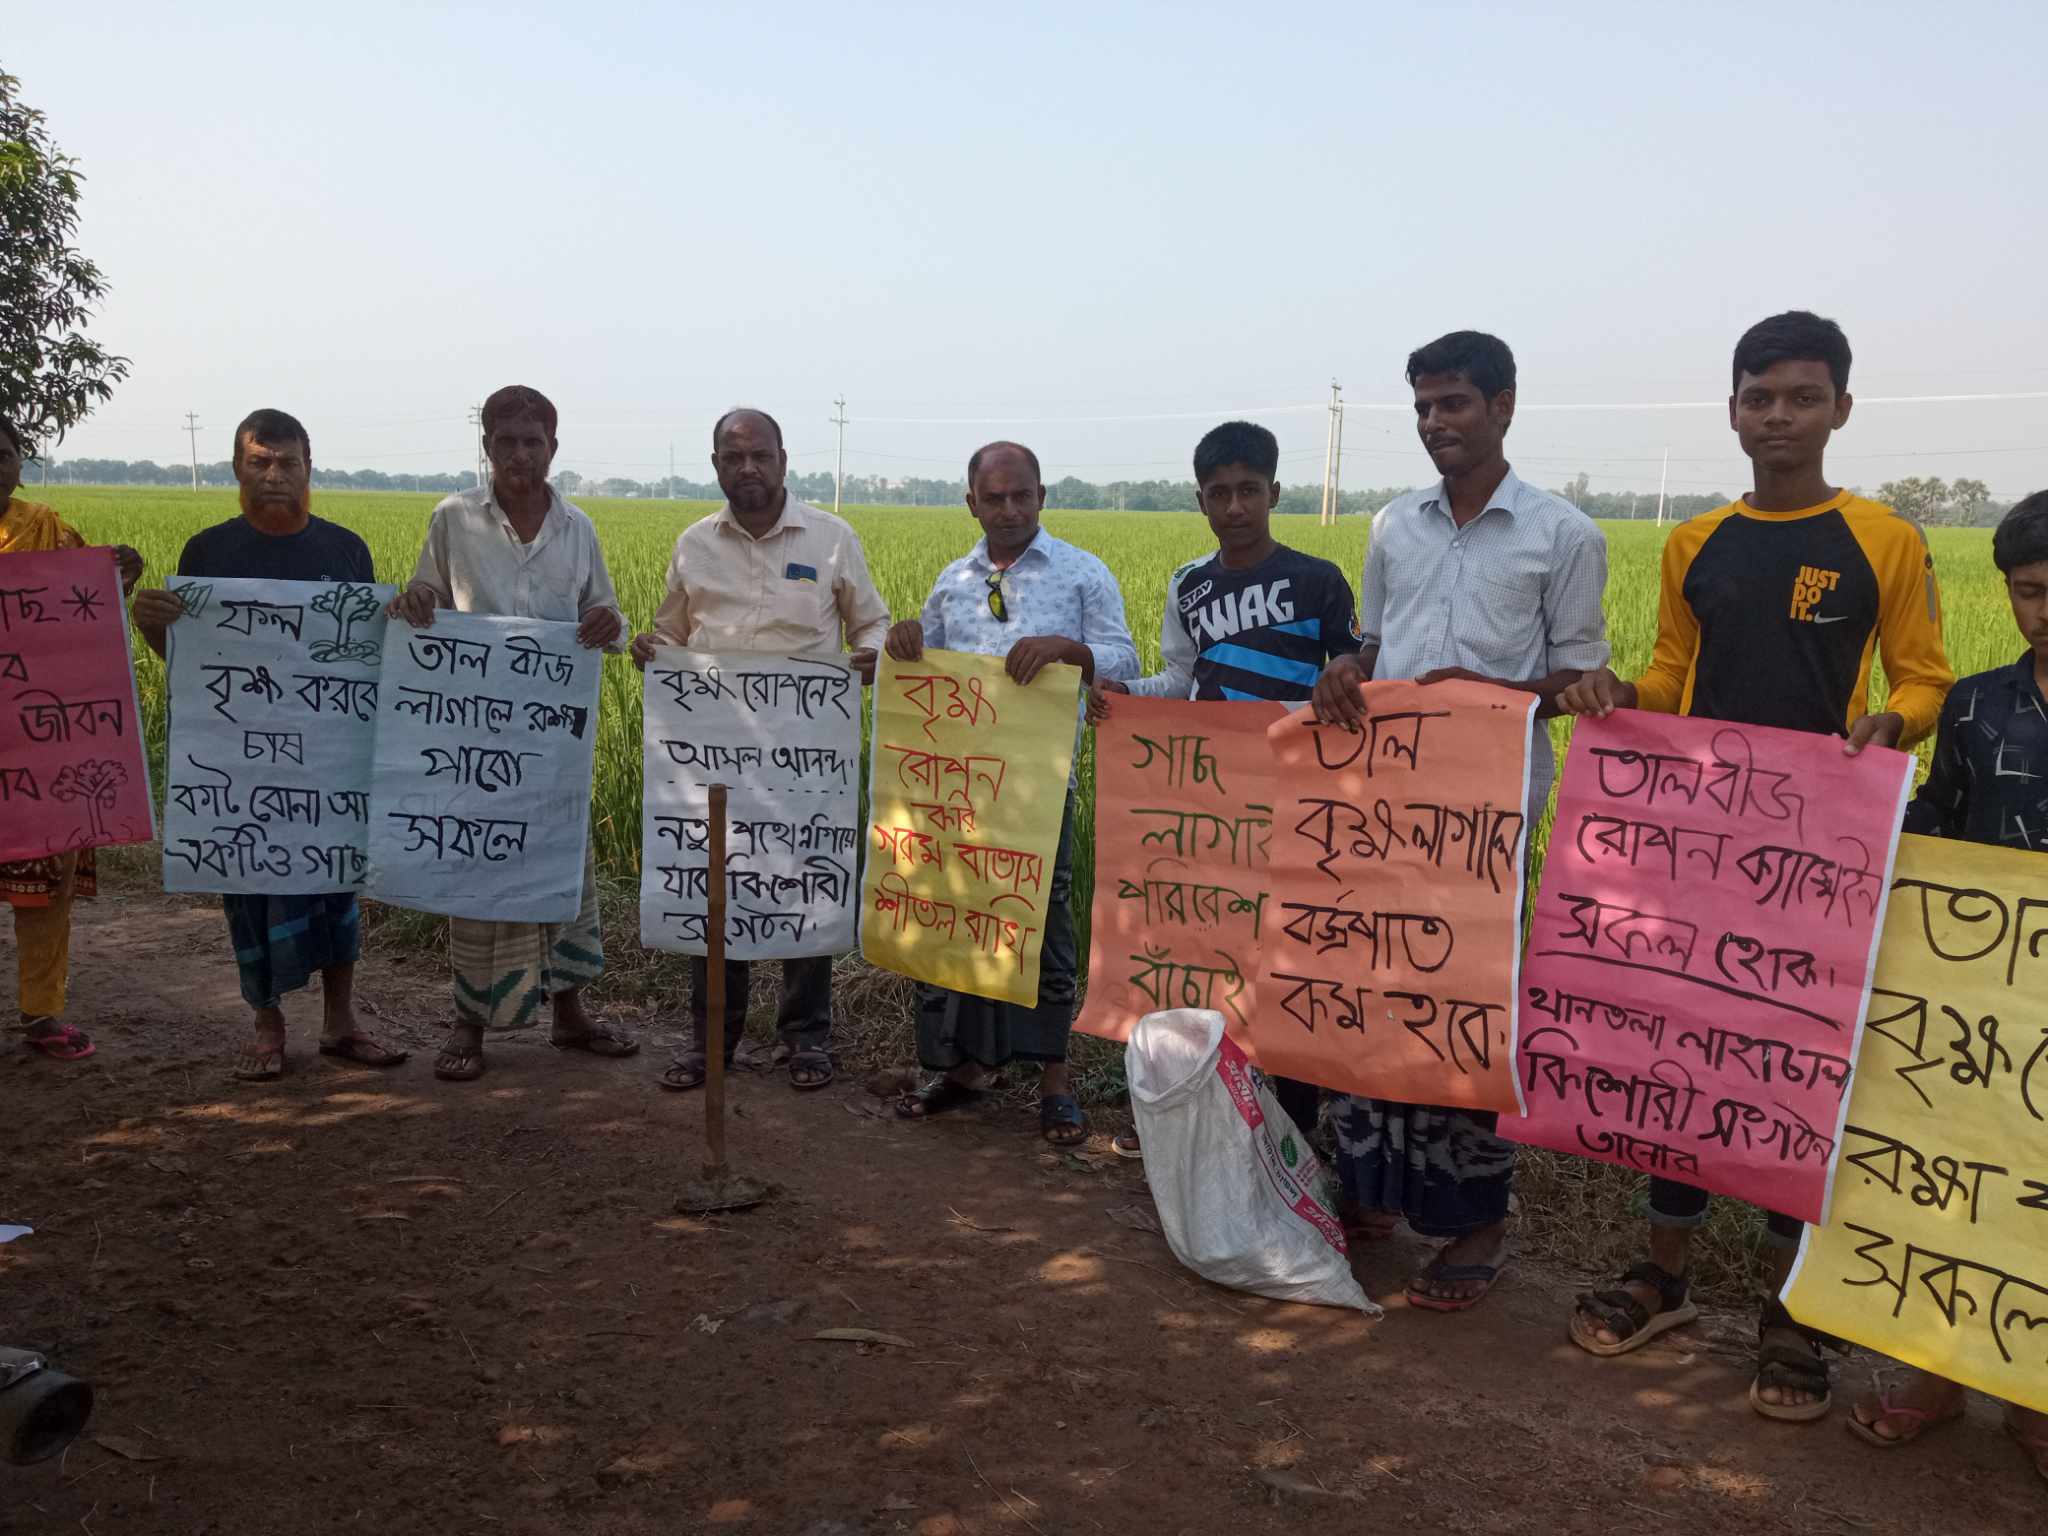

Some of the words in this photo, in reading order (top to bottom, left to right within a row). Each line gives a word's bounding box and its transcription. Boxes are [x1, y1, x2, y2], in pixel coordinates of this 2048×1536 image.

[1179, 579, 1213, 613] STAY
[1794, 583, 1822, 605] DO
[1796, 565, 1841, 591] JUST
[0, 587, 60, 632] াছ
[408, 634, 492, 678] তাল
[504, 635, 574, 686] বীজ
[652, 665, 738, 712] বৃক্ষ
[737, 657, 851, 720] রোপনেই
[12, 689, 123, 743] জীবন
[200, 664, 284, 723] বৃক্ষ
[394, 685, 513, 734] লাগালে
[895, 675, 997, 743] বৃক্ষ
[243, 730, 304, 765] চাষ
[420, 746, 543, 792] পাবো
[659, 739, 762, 775] আসল
[883, 744, 1006, 801] রোপন
[1131, 733, 1227, 796] গাছ
[1301, 710, 1452, 778] তাল
[387, 812, 528, 861] সকলে
[653, 815, 709, 853] নতু
[910, 789, 977, 833] করি
[1129, 803, 1273, 867] লাগাই
[874, 824, 943, 872] গরম
[952, 842, 1044, 894] বাতাস
[1575, 813, 1734, 881] রোপন
[874, 871, 957, 941] শীতল
[963, 893, 1037, 976] রাখি
[1117, 857, 1270, 940] পরিবেশ
[1128, 941, 1249, 1026] বাঁচাই
[1270, 972, 1374, 1035] কম
[1865, 987, 2013, 1110] বৃক্ষ
[1522, 1027, 1706, 1134] কিশোরী
[1697, 1098, 1837, 1167] সংগঠন
[1844, 1124, 2009, 1224] রক্ষা
